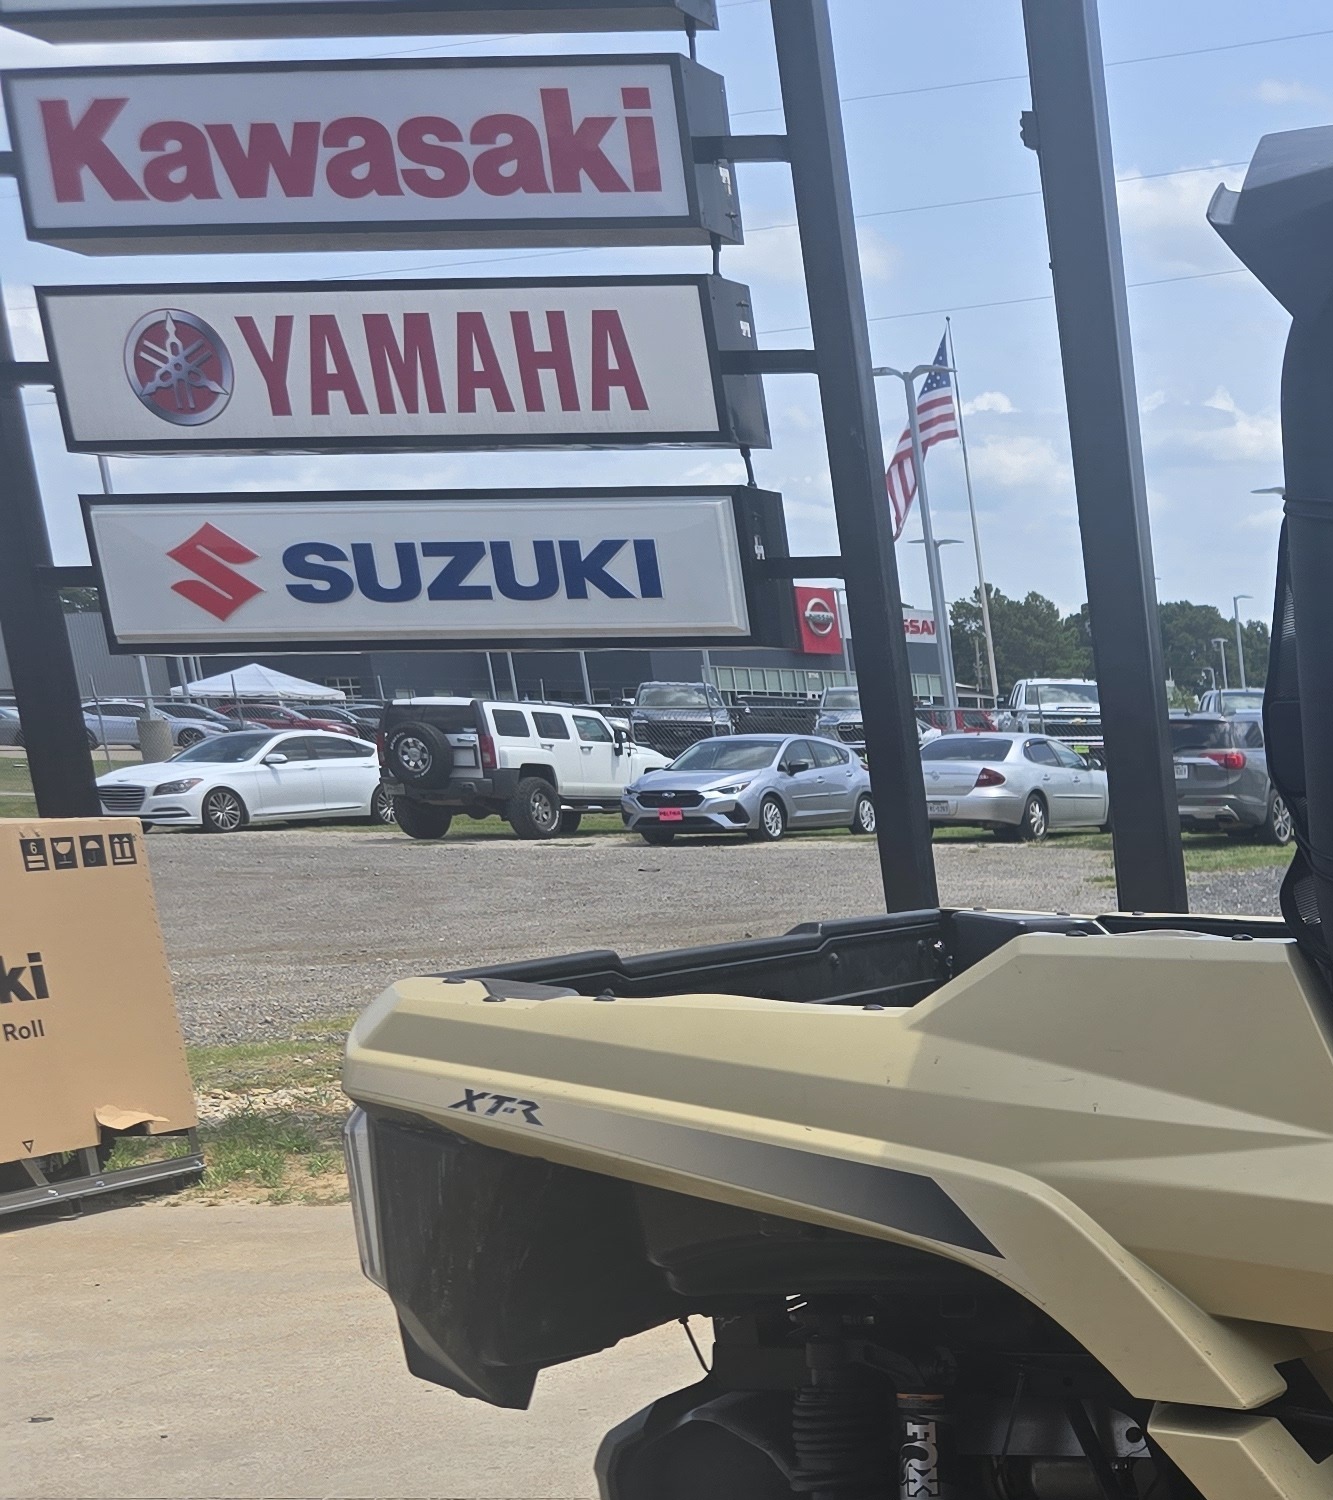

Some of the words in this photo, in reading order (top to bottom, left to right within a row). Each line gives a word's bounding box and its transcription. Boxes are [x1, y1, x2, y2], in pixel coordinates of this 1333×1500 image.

[39, 87, 663, 203] Kawasaki
[234, 309, 649, 417] YAMAHA
[281, 538, 664, 604] SUZUKI
[902, 619, 936, 636] SSA
[2, 1019, 46, 1042] Roll
[448, 1088, 544, 1127] XT-R
[900, 1421, 939, 1496] FOX
